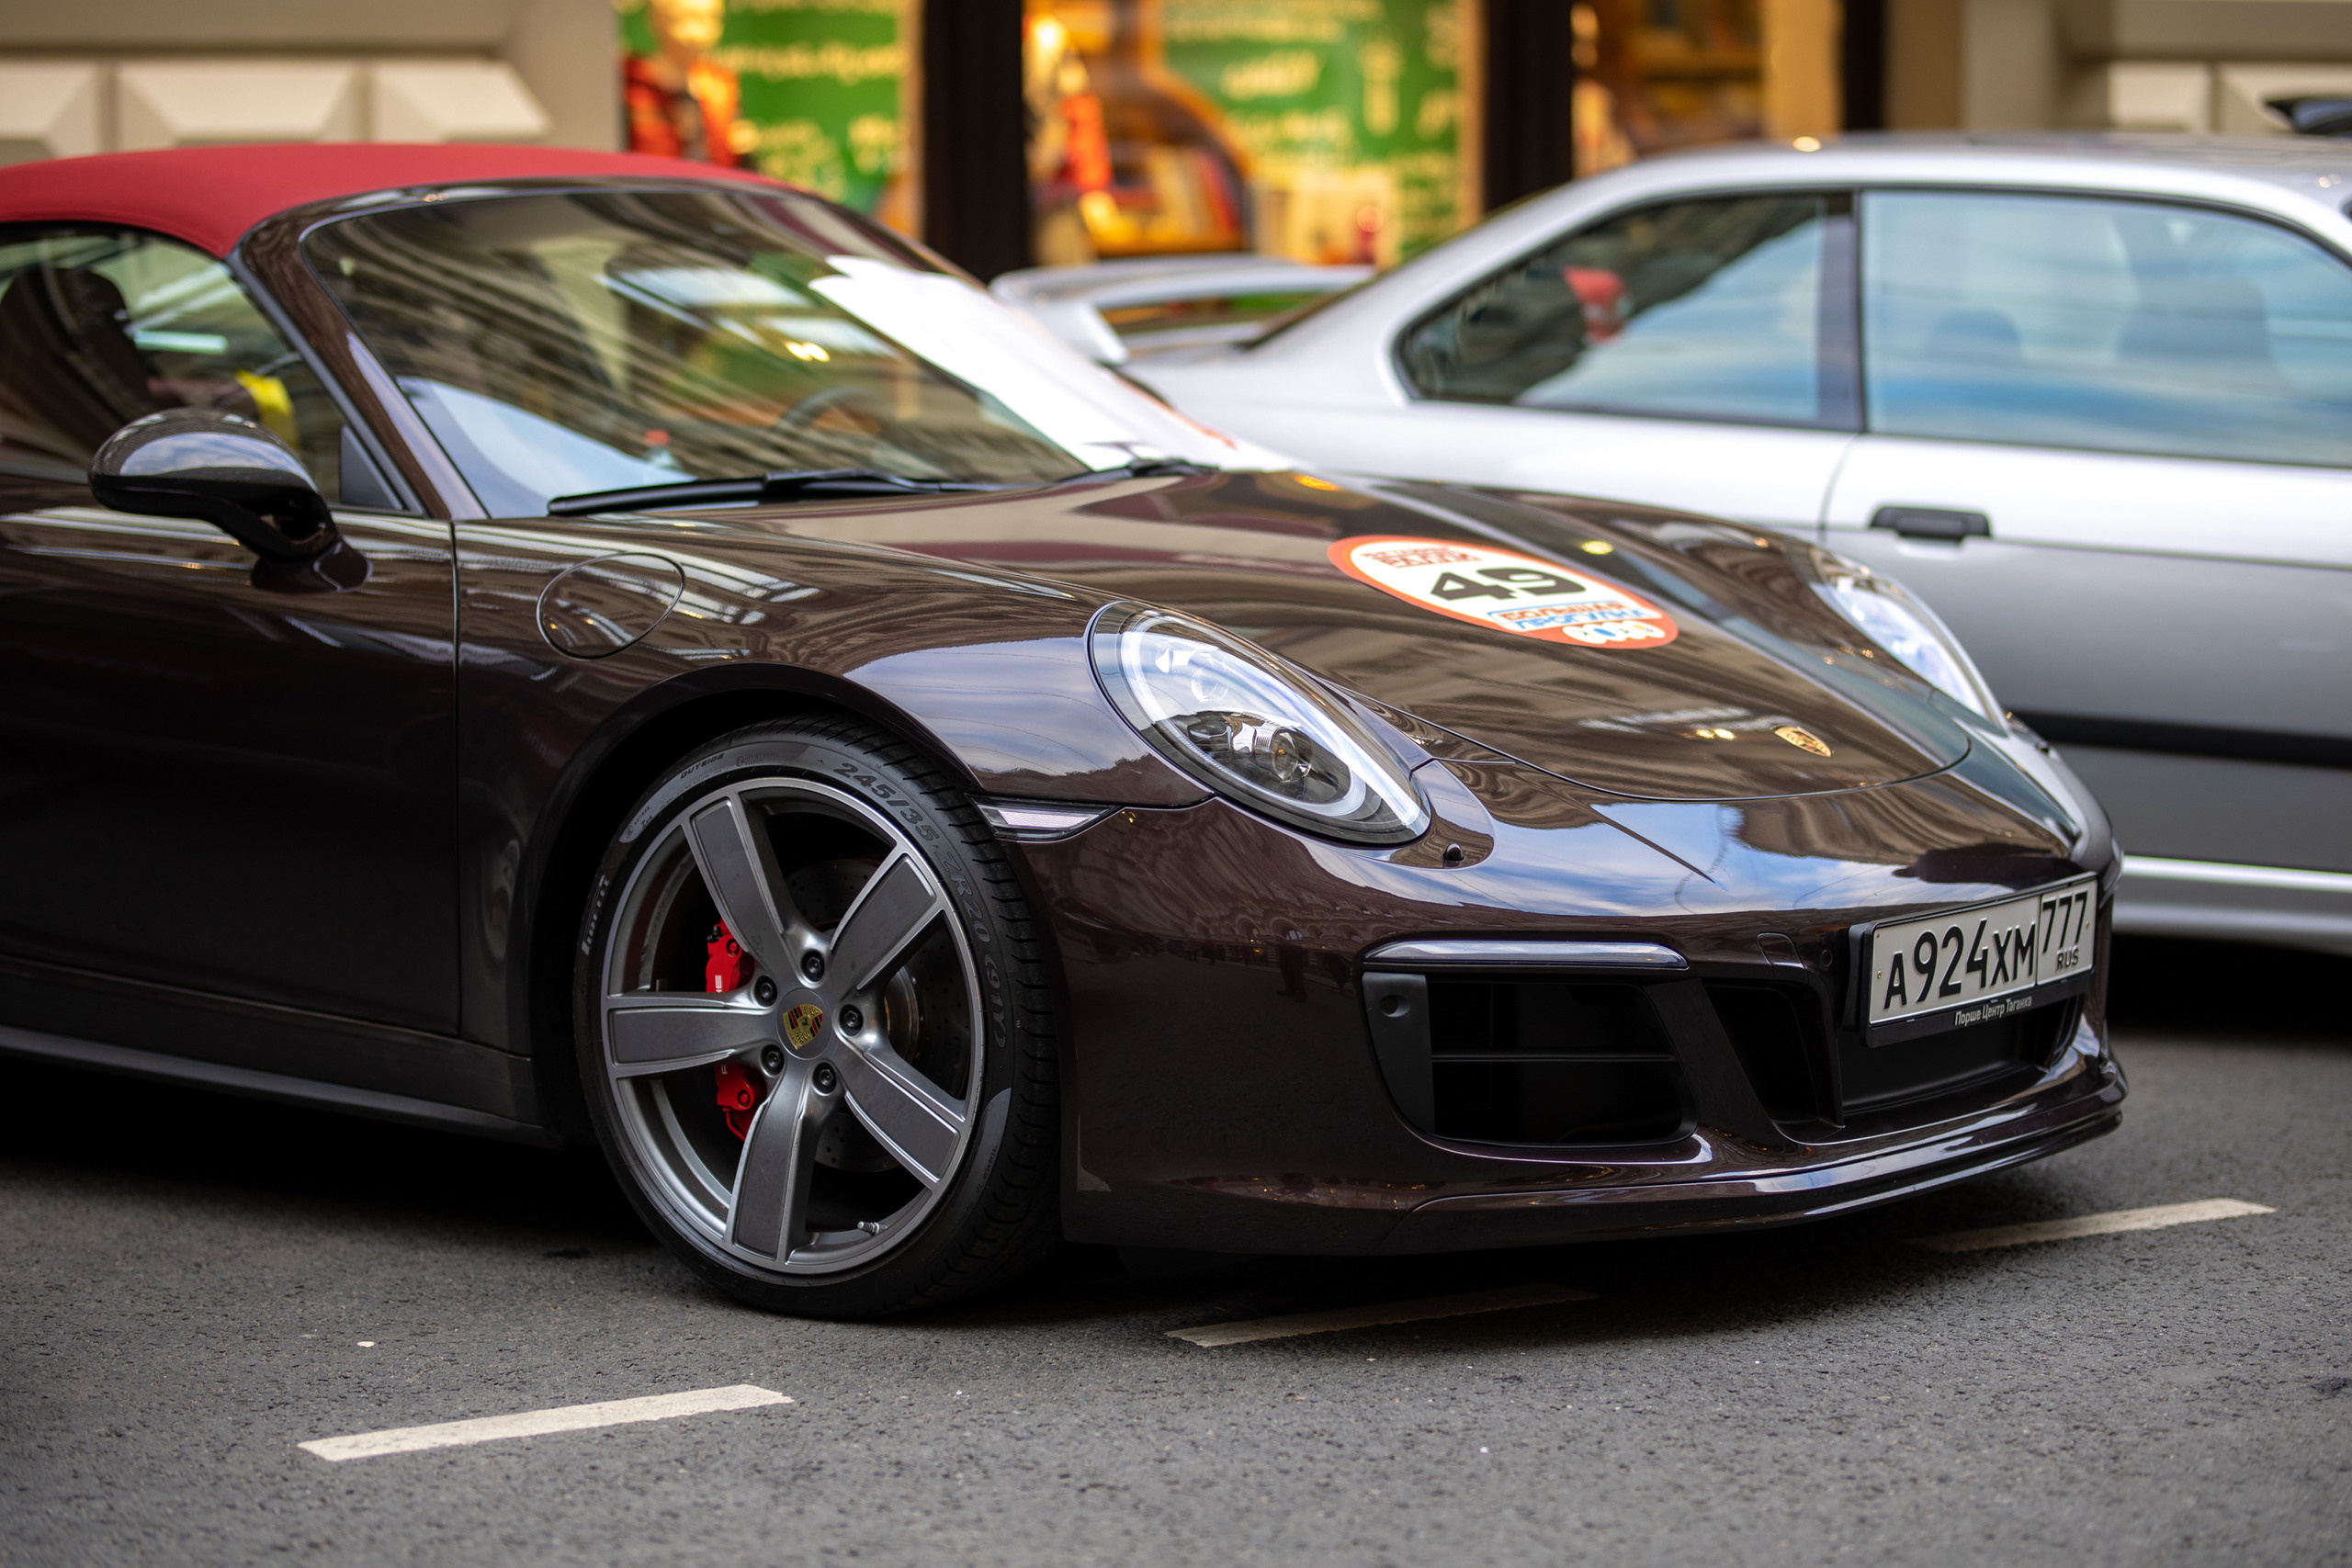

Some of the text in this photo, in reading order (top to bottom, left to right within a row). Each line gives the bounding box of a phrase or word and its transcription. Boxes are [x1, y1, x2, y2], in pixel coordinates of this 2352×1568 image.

[1430, 567, 1587, 602] 49
[681, 752, 725, 779] OUTSIDE
[832, 762, 940, 841] 245/35
[2042, 890, 2088, 954] 777
[2057, 947, 2079, 971] RUS
[1955, 997, 2032, 1027] Порше Центр Таганка
